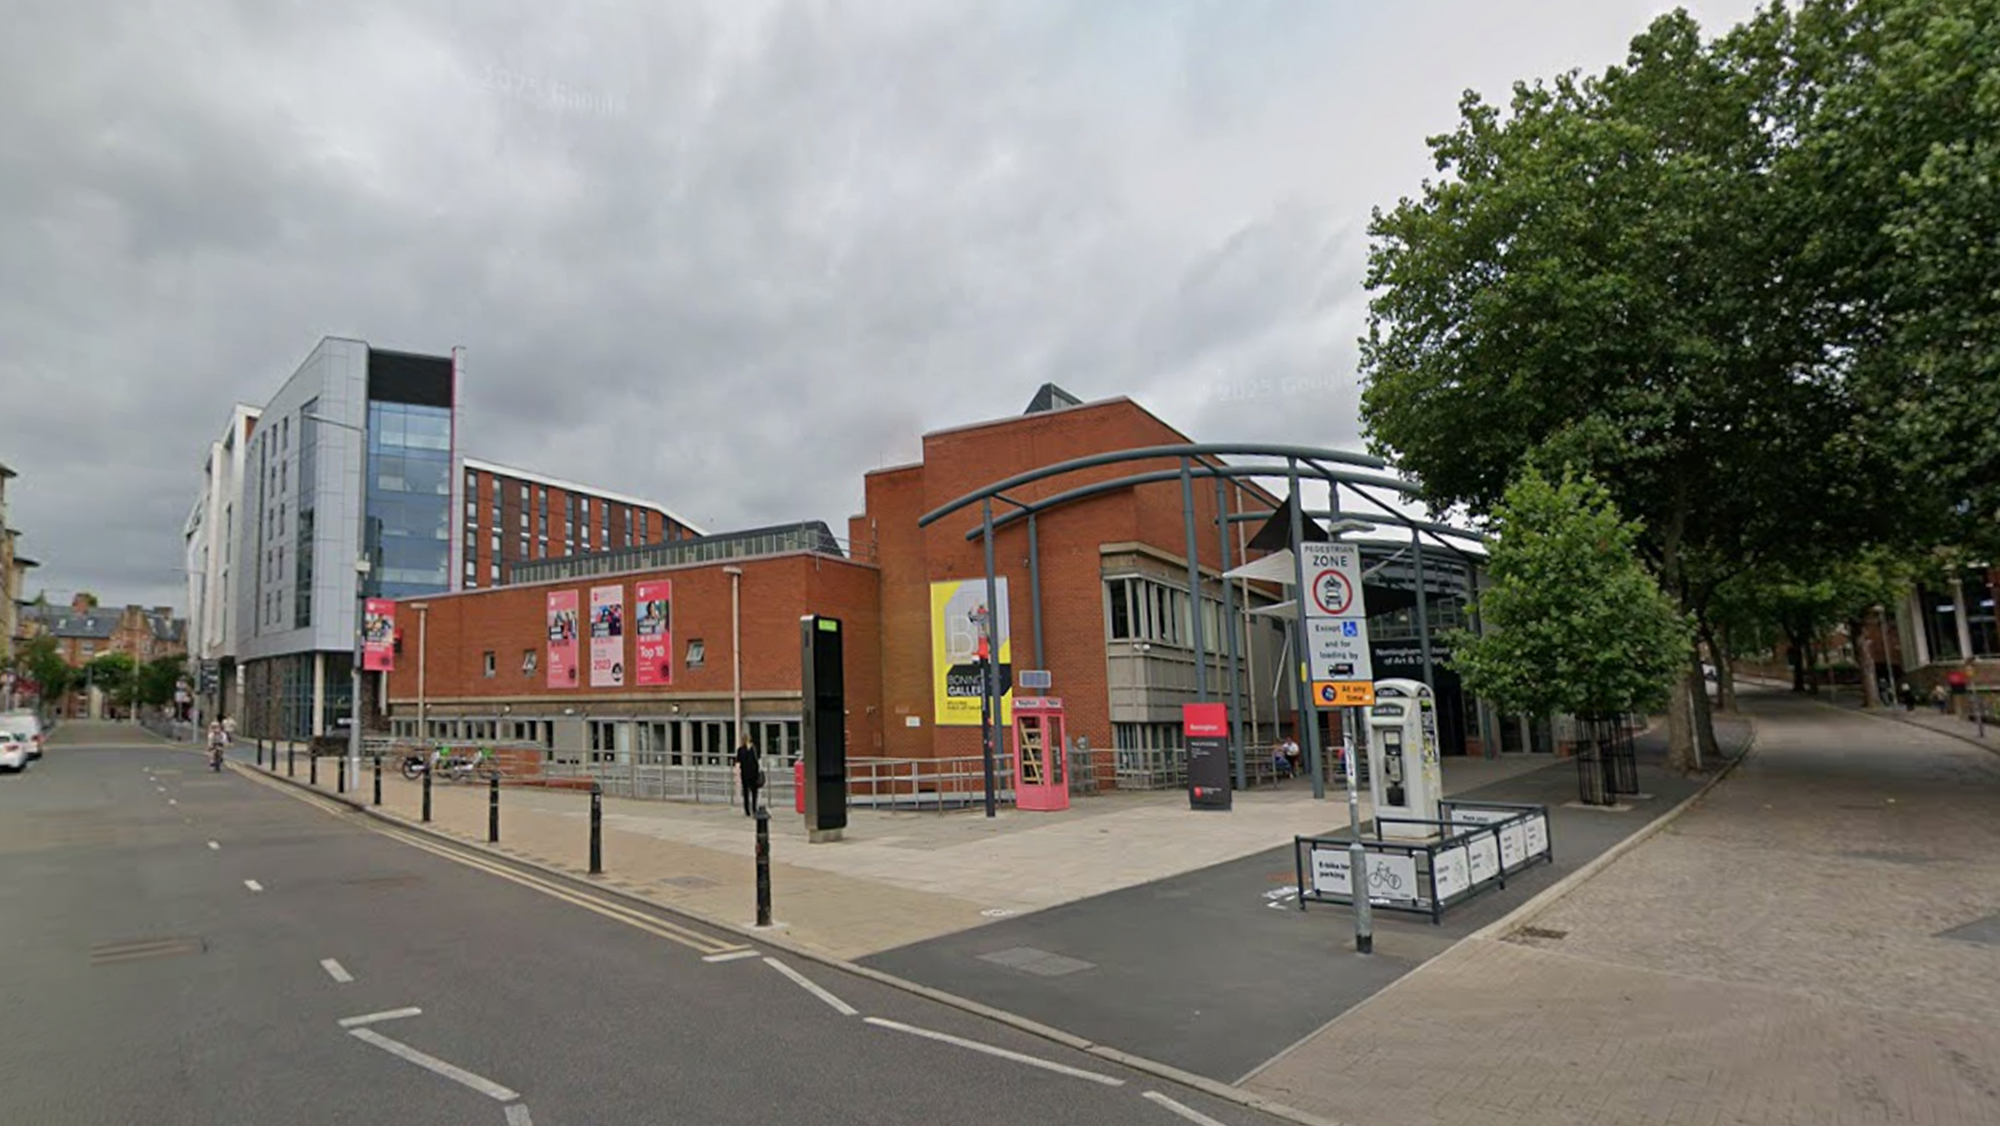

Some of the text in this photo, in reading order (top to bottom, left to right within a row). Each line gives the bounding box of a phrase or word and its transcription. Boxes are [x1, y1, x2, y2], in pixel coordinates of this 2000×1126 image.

[1304, 545, 1355, 553] PEDESTRIAN
[1312, 555, 1348, 567] ZONE
[1315, 624, 1341, 633] Except
[1340, 640, 1351, 648] for
[640, 645, 665, 660] Top 10
[1319, 651, 1359, 660] loading by
[1375, 648, 1422, 658] Nottingham
[1384, 656, 1392, 665] of
[1393, 656, 1406, 664] Art
[1353, 686, 1366, 694] any
[1462, 814, 1476, 822] Park
[1319, 861, 1339, 870] E-bike
[1319, 870, 1345, 880] parking
